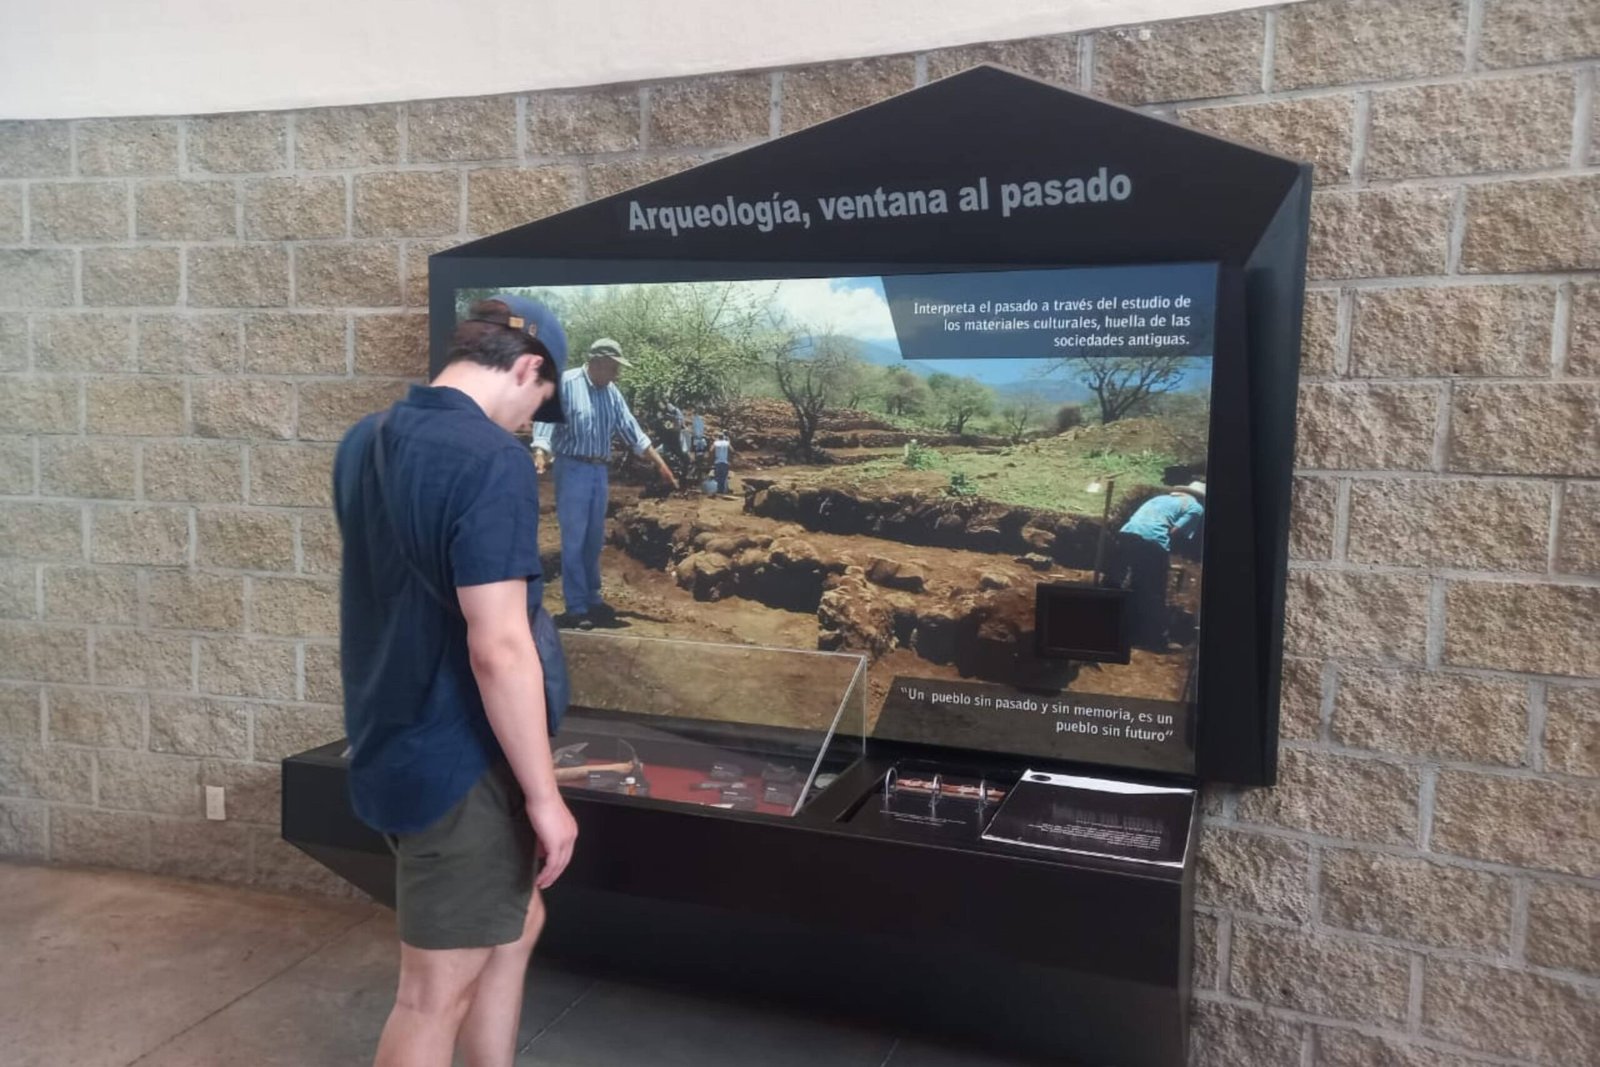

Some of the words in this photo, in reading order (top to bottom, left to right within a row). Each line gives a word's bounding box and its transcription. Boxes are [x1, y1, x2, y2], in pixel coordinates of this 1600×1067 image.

[629, 192, 811, 236] Arqueología,
[818, 186, 948, 220] ventana
[958, 177, 990, 211] al
[1001, 167, 1132, 217] pasado
[914, 301, 976, 316] Interpreta
[979, 300, 992, 313] el
[995, 299, 1038, 315] pasado
[1042, 302, 1050, 312] a
[1054, 297, 1093, 311] través
[1096, 297, 1117, 310] del
[1122, 295, 1170, 310] estudio
[1174, 294, 1191, 308] de
[944, 318, 961, 331] los
[964, 317, 1030, 331] materiales
[1034, 315, 1101, 331] culturales,
[1105, 314, 1146, 328] huella
[1150, 314, 1167, 327] de
[1171, 313, 1191, 327] las
[1054, 333, 1125, 347] sociedades
[1128, 333, 1190, 348] antiguas.
[931, 691, 971, 705] pueblo
[974, 694, 991, 706] sin
[995, 697, 1037, 712] pasado
[1041, 702, 1049, 714] y
[1052, 701, 1070, 714] sin
[1074, 705, 1134, 723] memoria,
[1138, 713, 1153, 724] es
[1157, 714, 1173, 725] un
[1056, 720, 1098, 735] pueblo
[1102, 723, 1120, 737] sin
